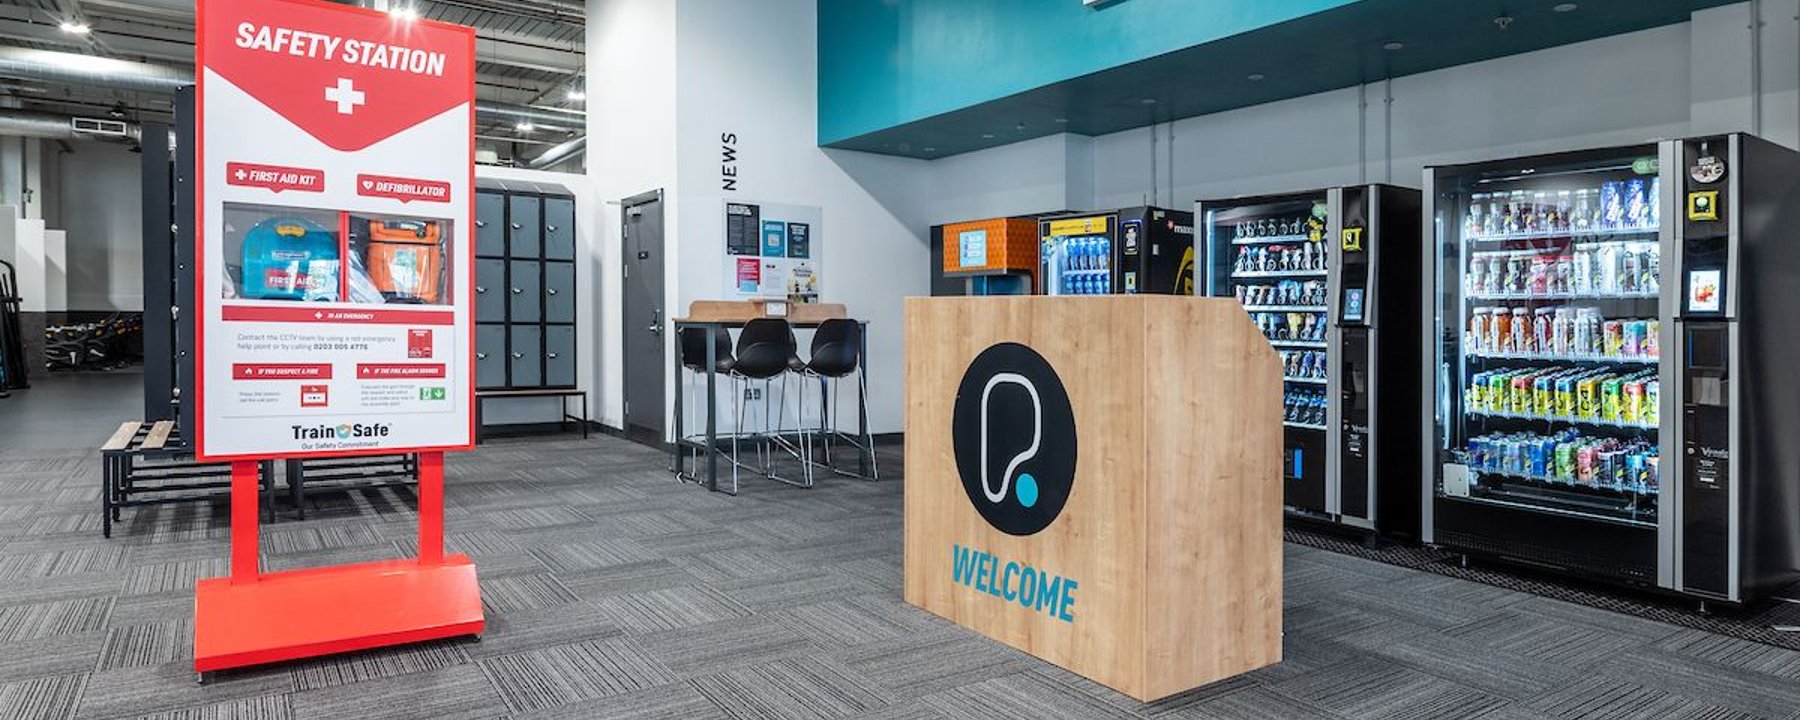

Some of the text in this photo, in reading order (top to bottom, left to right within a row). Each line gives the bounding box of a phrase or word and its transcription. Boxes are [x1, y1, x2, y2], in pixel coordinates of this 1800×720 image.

[235, 21, 445, 77] SAFETY STATION
[721, 132, 737, 191] NEWS
[249, 169, 316, 186] FIRST AID KIT
[376, 181, 446, 197] DEFIBRILLATOR
[343, 312, 374, 320] EMERGENCY
[237, 333, 265, 341] Contact
[266, 333, 279, 341] the
[317, 335, 325, 343] by
[325, 335, 344, 343] using
[362, 336, 396, 344] emergency
[237, 343, 252, 351] help
[253, 343, 272, 351] point
[281, 343, 290, 351] by
[291, 343, 313, 351] calling
[291, 423, 389, 440] Train Safe
[301, 442, 313, 450] Our
[337, 441, 379, 449] Commitment
[953, 544, 1078, 623] WELCOME
